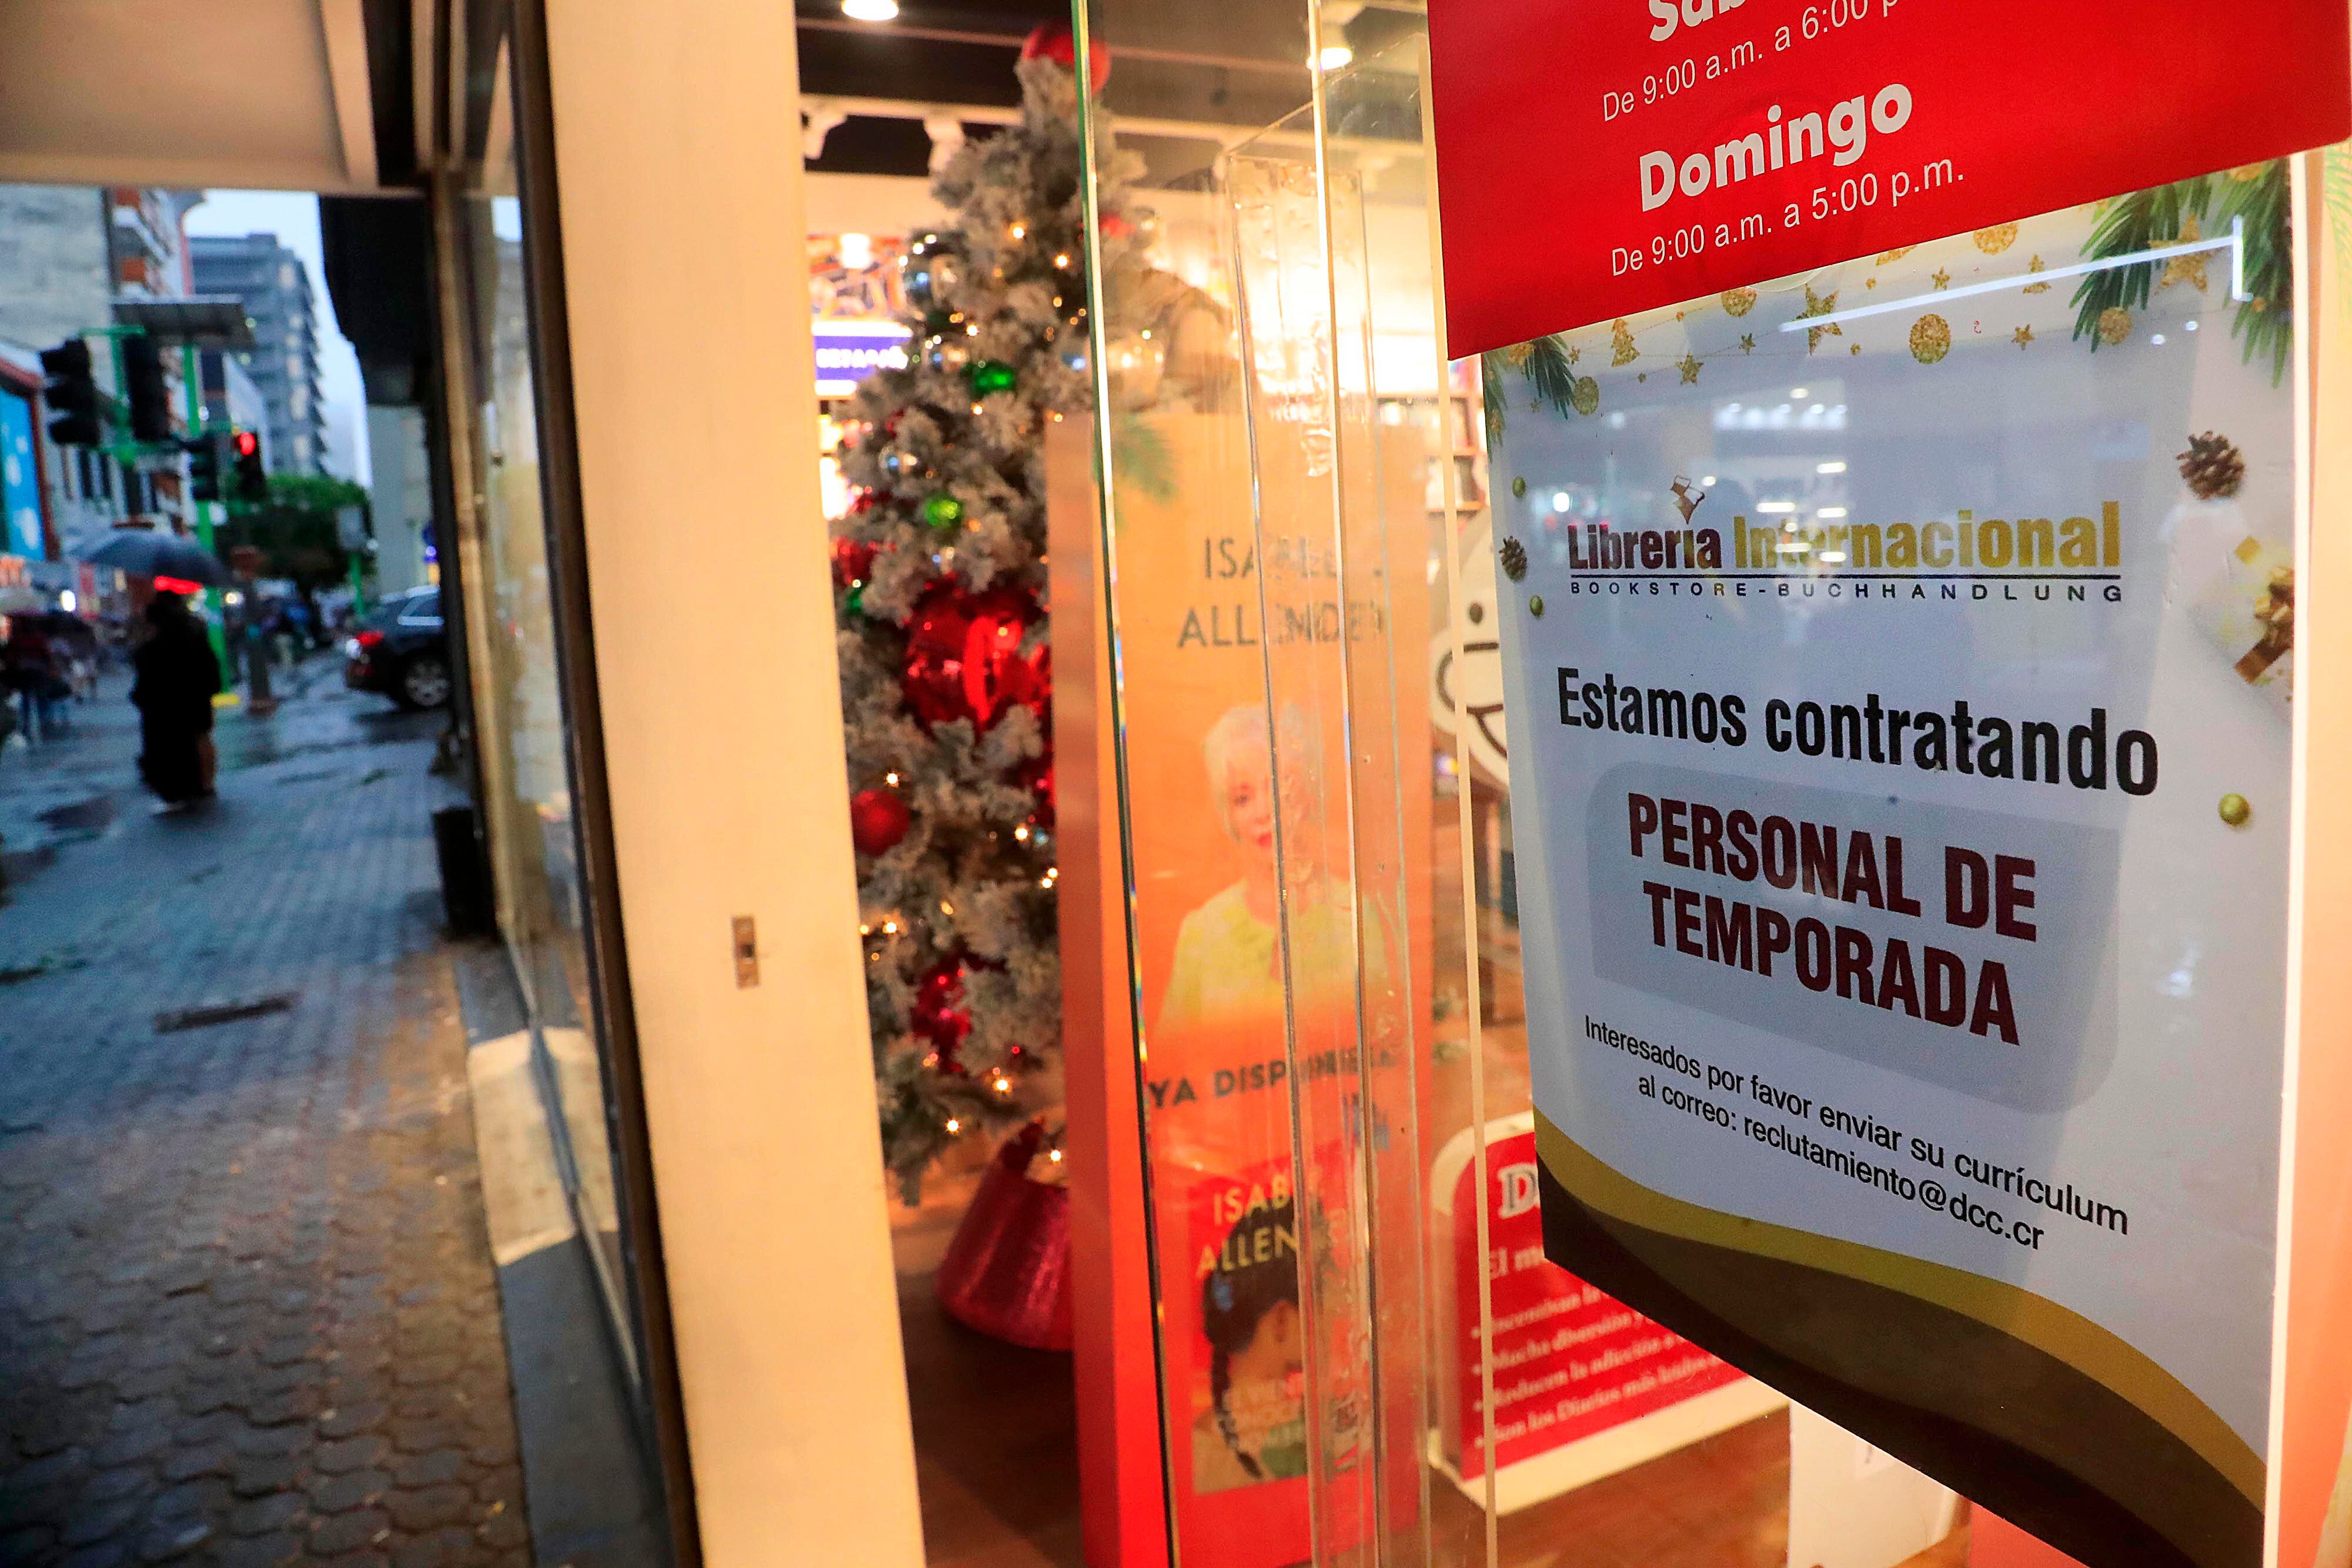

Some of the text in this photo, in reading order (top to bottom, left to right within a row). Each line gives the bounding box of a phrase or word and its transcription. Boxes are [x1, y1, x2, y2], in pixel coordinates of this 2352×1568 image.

[1603, 91, 1635, 122] De
[1643, 58, 1696, 106] 9:00
[1705, 40, 1763, 80] a.m.
[1774, 26, 1791, 52] a
[1801, 0, 1869, 40] 6:00
[1639, 83, 1913, 212] Domingo
[1612, 157, 1965, 276] De 9:00 a.m. a 5:00 p.m.
[1733, 500, 2120, 571] Internacional
[1557, 666, 2159, 797] Estamos contratando
[1628, 792, 2038, 942] PERSONAL DE
[1643, 880, 2021, 1047] TEMPORADA
[1148, 1075, 1197, 1109] YA
[1585, 1014, 2130, 1236] Interesados por favor enviar su currículum
[1638, 1073, 2046, 1252] al correo: reclutamiento@dcc.cr
